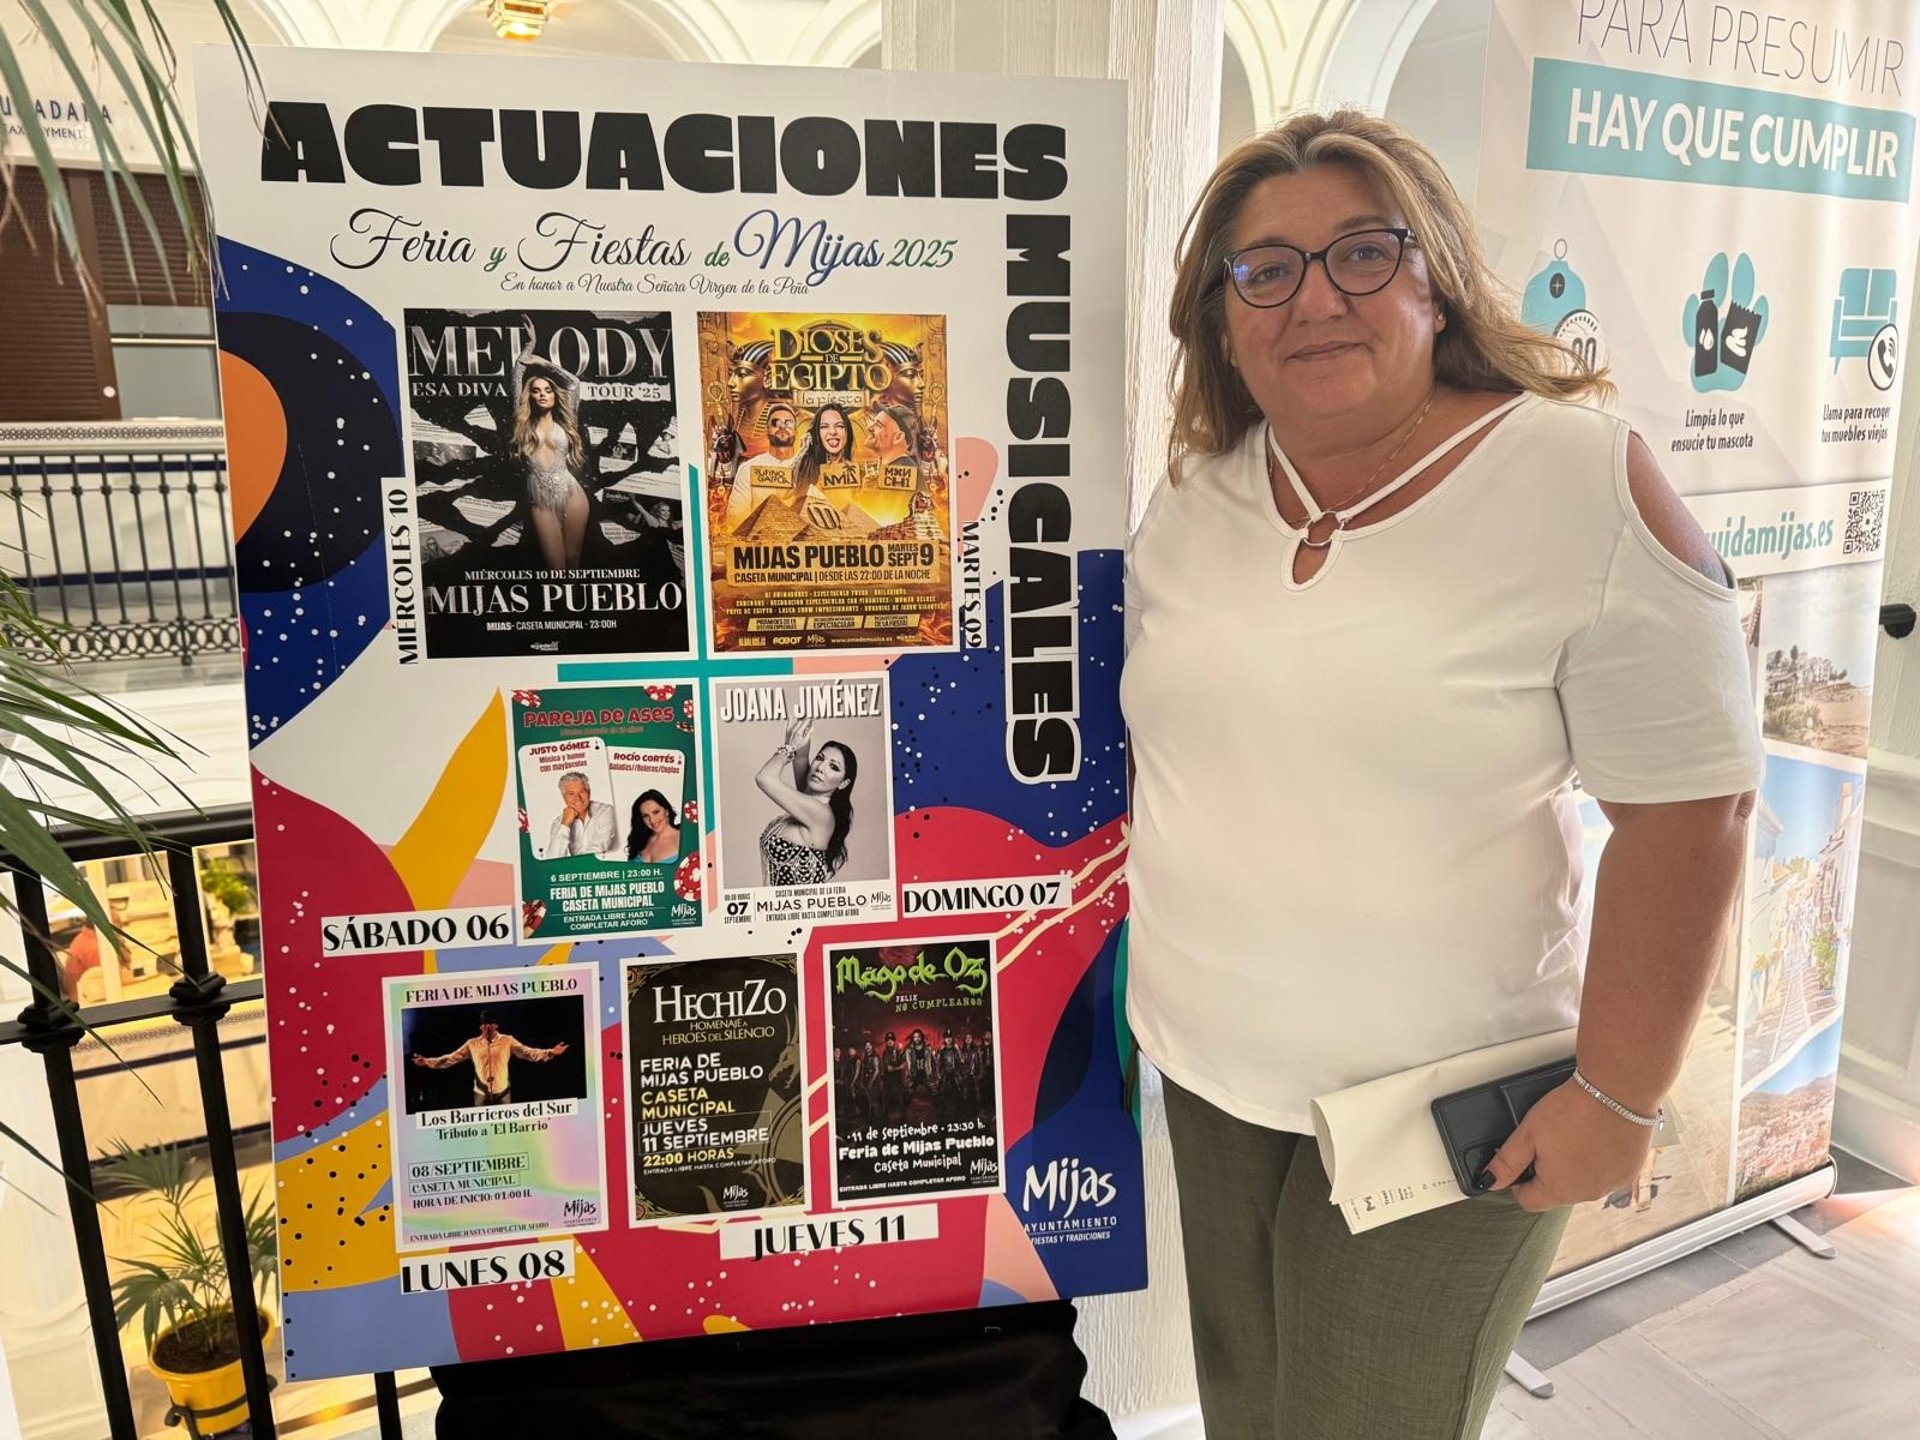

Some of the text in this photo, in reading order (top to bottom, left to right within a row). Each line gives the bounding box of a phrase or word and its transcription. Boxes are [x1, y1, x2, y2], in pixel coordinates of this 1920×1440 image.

[1577, 0, 1905, 97] PARA PRESUMIR
[1568, 87, 1900, 179] HAY QUE CUMPLIR
[261, 101, 1068, 201] ACTUACIONES
[330, 208, 958, 287] Feria y Fiestas de Mijas 2025
[501, 271, 809, 298] En honor a Nuestra Señora Virgen de la Peña
[408, 325, 672, 379] MELODY
[773, 328, 884, 363] DIOSES
[825, 353, 840, 363] DE
[770, 363, 893, 391] EGIPTO
[412, 382, 452, 397] ESA
[458, 382, 508, 397] DIVA
[587, 385, 635, 399] TOUR
[1685, 408, 1745, 429] Limpia lo que
[1823, 404, 1890, 423] Llama para recoger
[1671, 432, 1753, 452] ensucie tu mascota
[1822, 424, 1888, 443] tus muebles viejos
[388, 489, 409, 518] 10
[1006, 214, 1075, 777] MUSICALES
[1706, 511, 1834, 560] uidamijas.es
[734, 543, 934, 570] MIJAS PUEBLO 9
[887, 543, 919, 553] MARTES
[888, 552, 919, 567] SEPT
[962, 521, 982, 616] MARTES
[465, 569, 640, 580] MIÉRCOLES 10 DE SEPTIEMBRE
[734, 568, 931, 583] CASETA MUNICIPAL DESDE LAS 22:00 NOCHE
[429, 582, 683, 616] MIJAS PUEBLO
[965, 618, 983, 648] 09
[720, 678, 882, 722] JOANA JIMÉNEZ
[529, 740, 590, 755] JUSTO GÓMEZ
[642, 754, 675, 763] CORTÉS
[551, 869, 651, 883] 6 SEPTIEMBRE 23:00
[550, 881, 665, 900] FERIA DE MIJAS PUEBLO
[904, 881, 1061, 913] DOMINGO 07
[562, 895, 655, 912] CASETA MUNICIPAL
[671, 903, 697, 918] Mijas
[727, 901, 749, 916] 07
[756, 899, 801, 912] MIJAS
[807, 894, 867, 909] PUEBLO
[323, 912, 509, 951] SÁBADO 06
[908, 951, 949, 986] de
[944, 946, 988, 997] Oz
[406, 978, 578, 1003] FERIA DE MIJAS PUEBLO
[690, 1018, 743, 1031] HOMENAJE
[662, 1025, 775, 1046] HEROES DEL SILENCIO
[640, 1053, 721, 1073] FERIA DE
[641, 1065, 763, 1088] MIJAS PUEBLO
[641, 1087, 709, 1105] CASETA
[421, 1101, 573, 1127] Los Barrieros del Sur
[642, 1100, 736, 1120] MUNICIPAL
[436, 1128, 478, 1140] Tributo
[642, 1118, 708, 1137] JUEVES
[852, 1131, 863, 1142] 11
[866, 1126, 878, 1141] de
[947, 1121, 974, 1132] 23:30
[642, 1128, 769, 1152] 11 SEPTIEMBRE
[839, 1135, 995, 1160] Feria de Mijas Pueblo
[643, 1147, 735, 1167] 22:00 HORAS
[970, 1157, 998, 1176] Mijas
[412, 1175, 516, 1194] CASETA MUNICIPAL
[723, 1184, 749, 1200] Mijas
[1022, 1157, 1117, 1218] Mijas
[413, 1197, 442, 1208] HORA
[444, 1195, 459, 1206] DE
[563, 1198, 596, 1219] Mijas
[1024, 1216, 1117, 1233] AYUNTAMIENTO
[752, 1214, 905, 1261] JUEVES 11
[1065, 1231, 1111, 1242] TRADICIONES
[402, 1249, 565, 1293] LUNES 08
